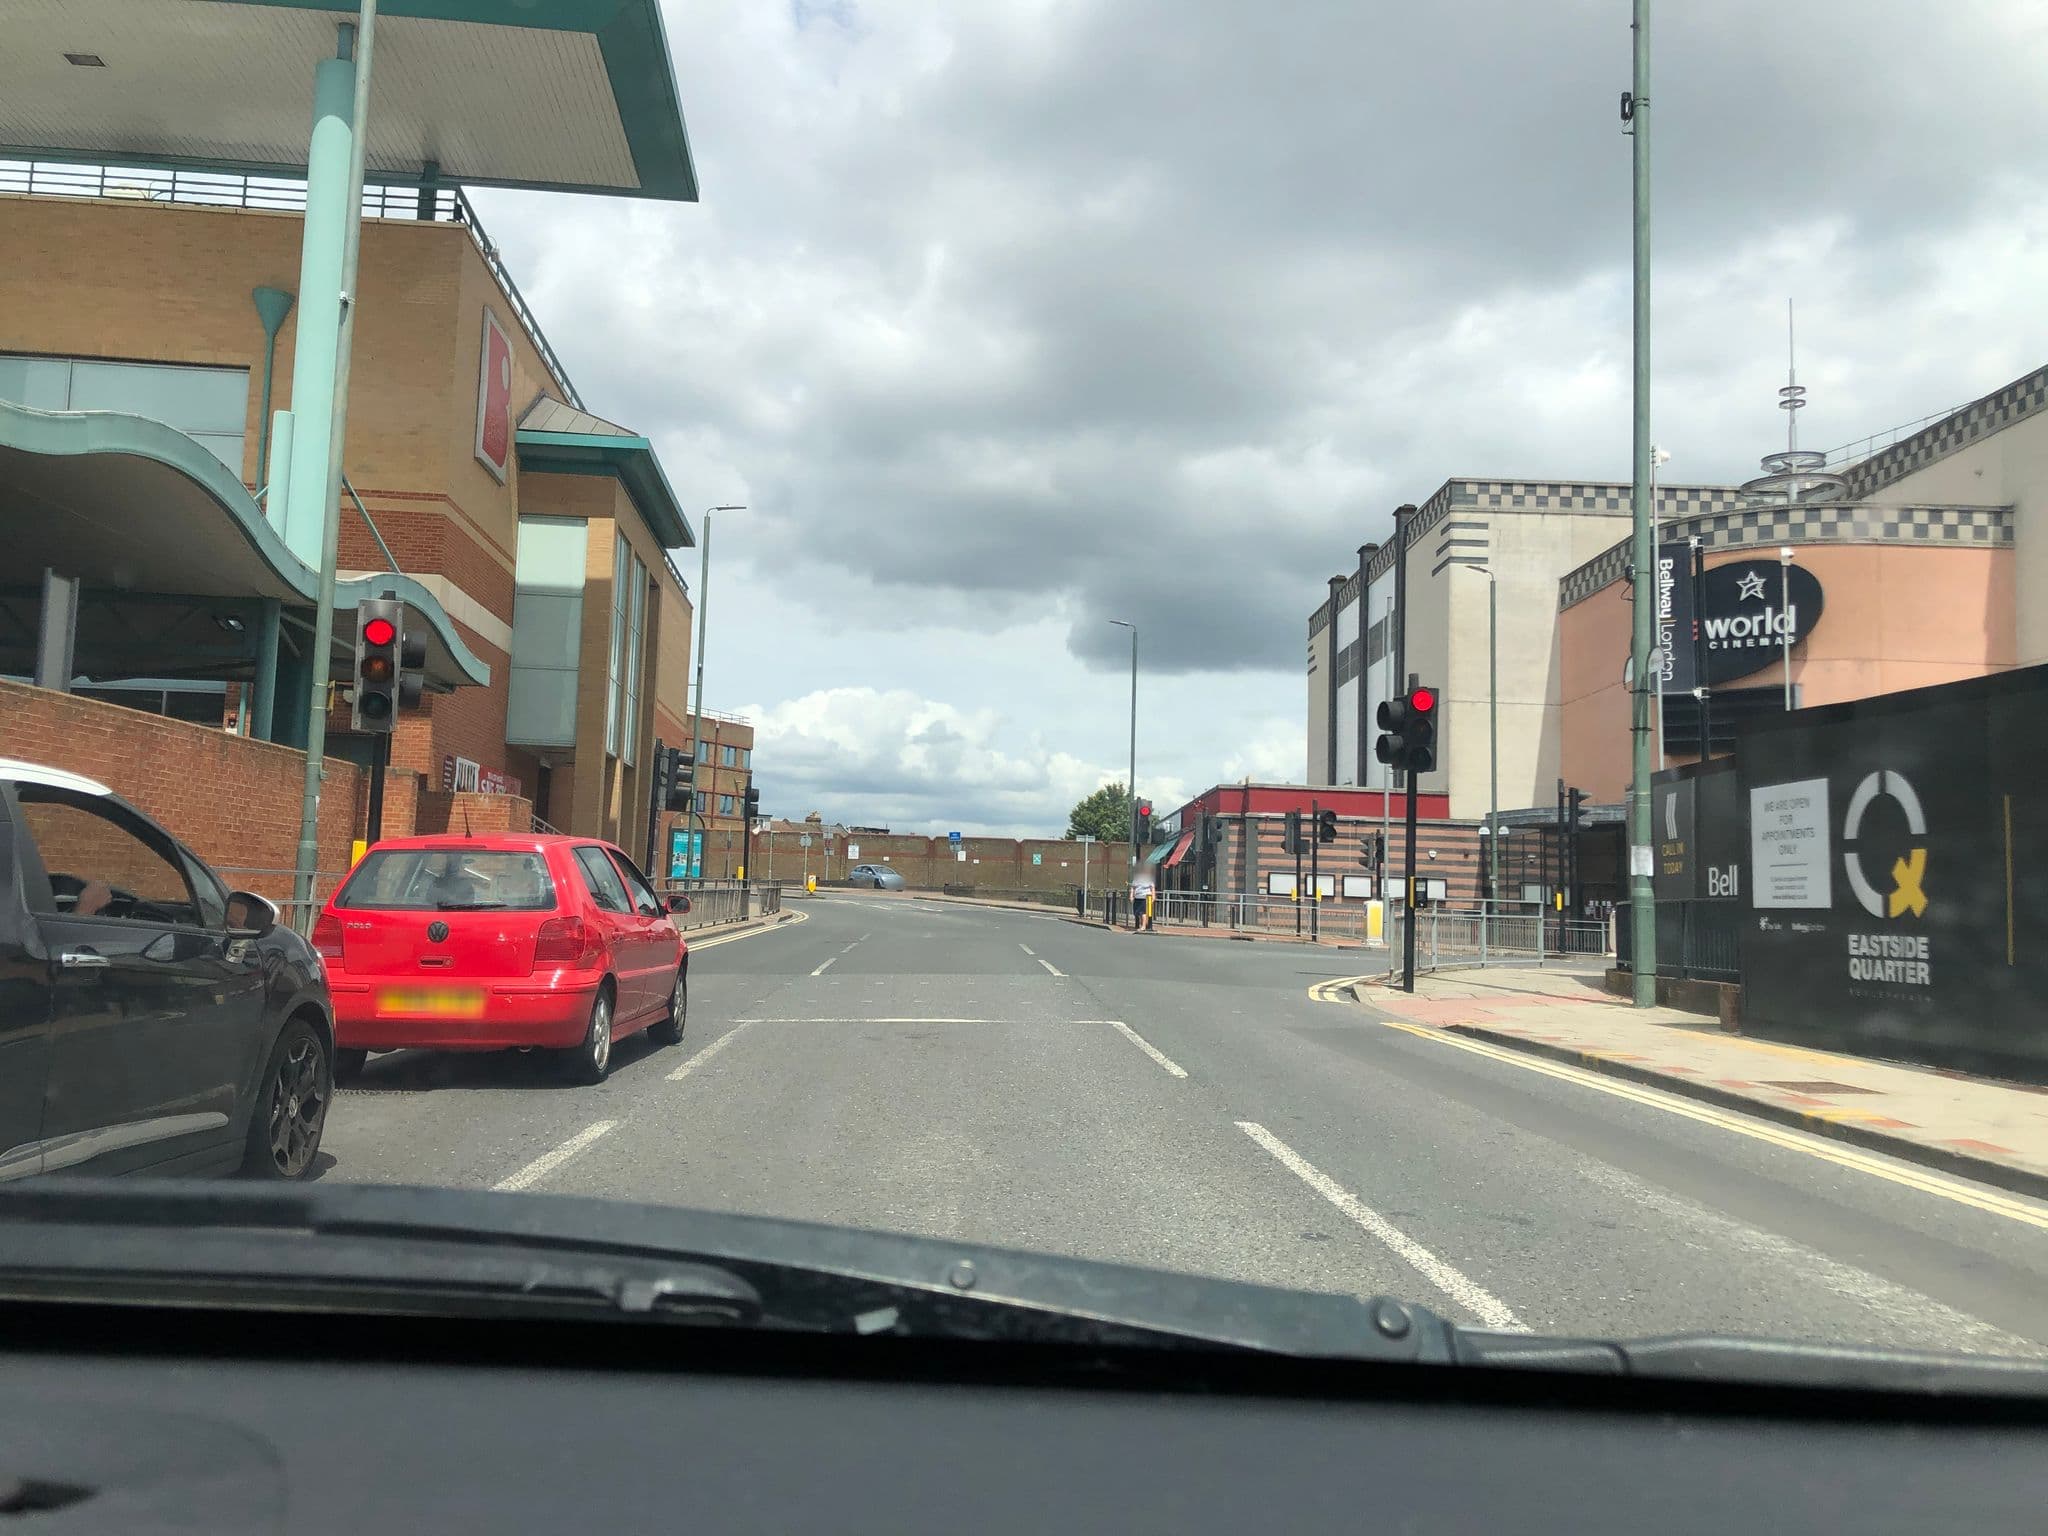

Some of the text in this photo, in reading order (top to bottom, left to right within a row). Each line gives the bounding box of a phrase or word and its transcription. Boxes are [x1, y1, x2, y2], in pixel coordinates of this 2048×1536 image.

[1659, 558, 1677, 681] Bellway London
[1848, 934, 1930, 959] EASTSIDE
[1849, 958, 1931, 985] QUARTER
